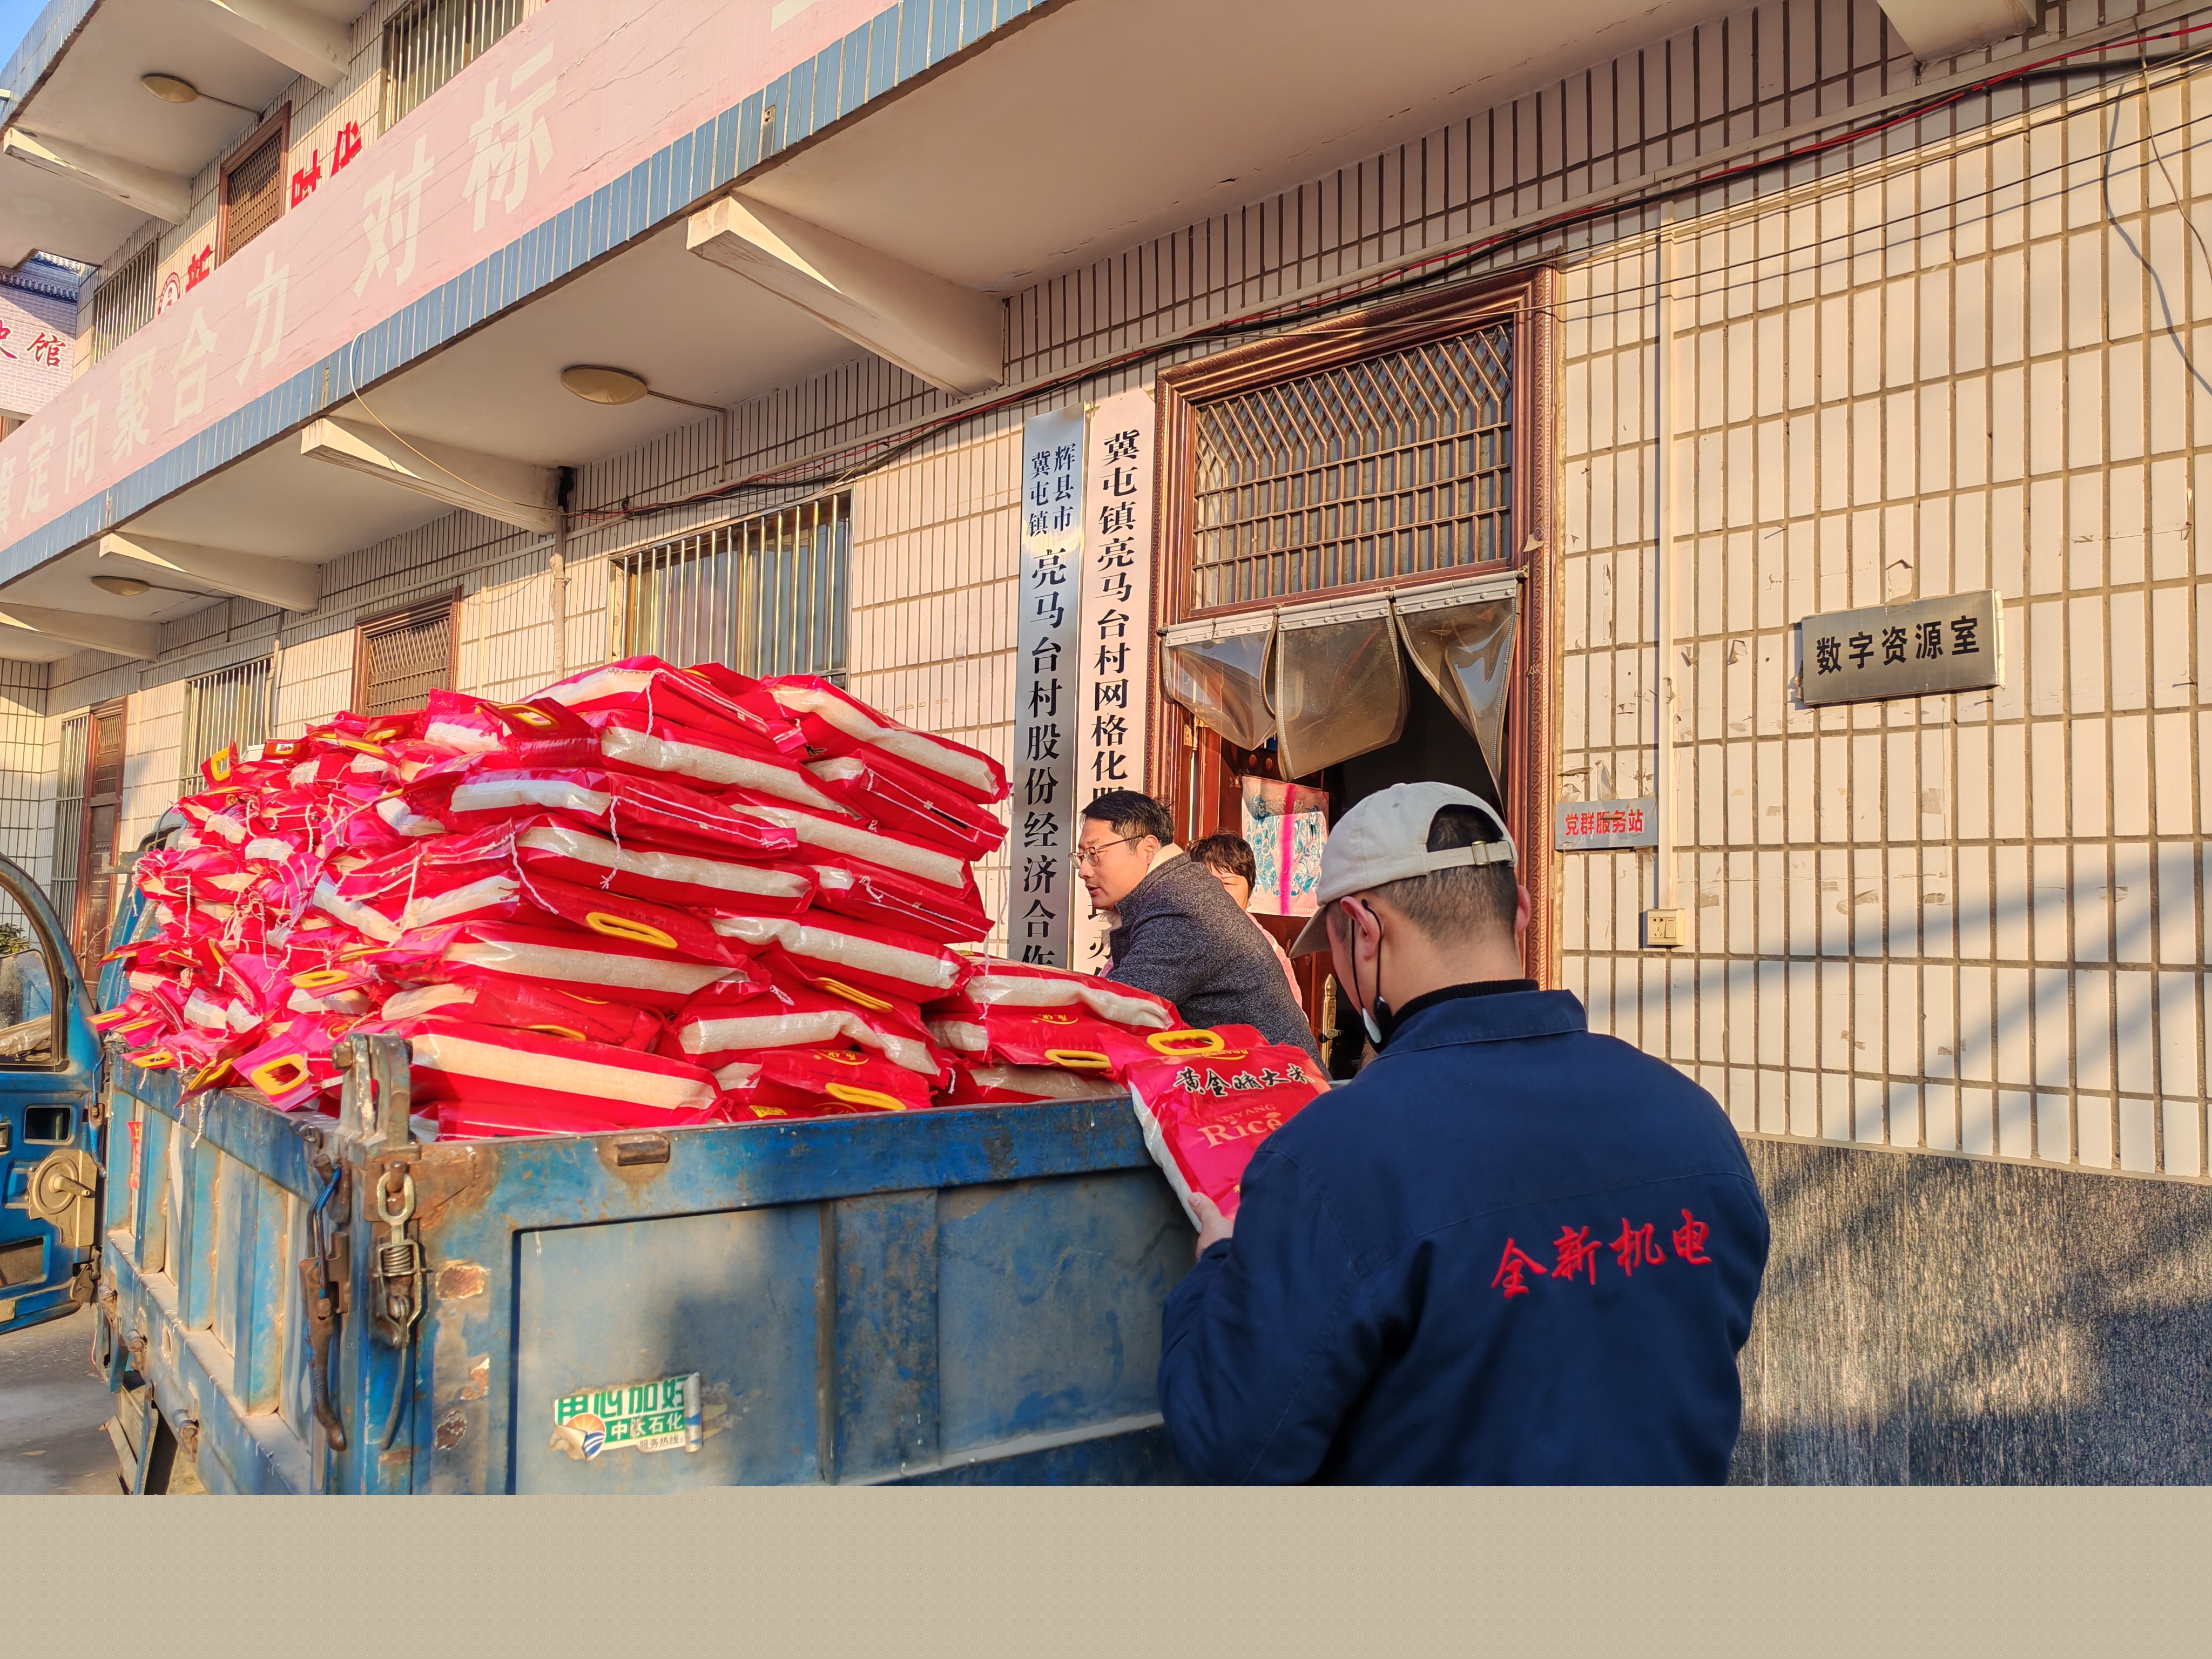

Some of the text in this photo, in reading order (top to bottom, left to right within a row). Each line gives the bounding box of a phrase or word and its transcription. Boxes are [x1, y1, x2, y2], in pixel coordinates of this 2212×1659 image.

[353, 41, 557, 299] 对标
[1028, 450, 1051, 538] 冀屯镇
[1053, 443, 1076, 532] 辉县市
[1090, 429, 1141, 802] 冀屯镇亮马台村网格化
[1816, 615, 1980, 676] 数字资源室
[1564, 808, 1644, 836] 党群服务站
[1197, 1118, 1283, 1150] Rice
[1490, 1208, 1712, 1298] 全新机电
[557, 1378, 686, 1425] 用心加好
